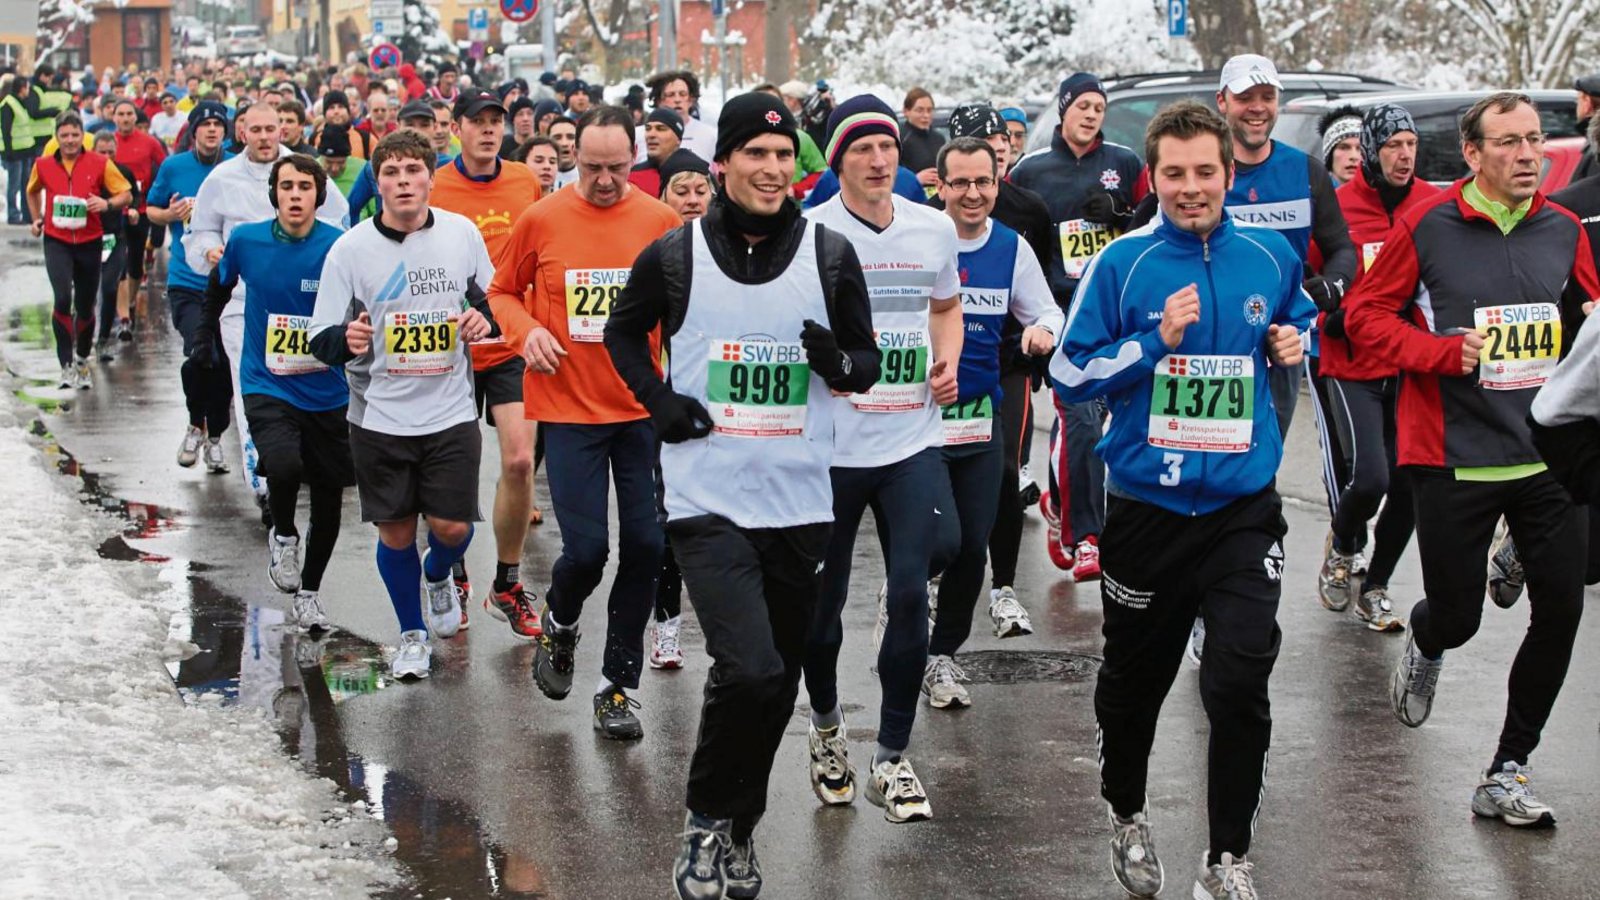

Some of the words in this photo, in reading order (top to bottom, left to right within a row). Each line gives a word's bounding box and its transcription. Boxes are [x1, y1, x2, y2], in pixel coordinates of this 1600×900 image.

[1170, 0, 1183, 31] P
[59, 203, 80, 216] 937
[1231, 210, 1297, 223] NTANIS
[408, 267, 446, 283] DÜRR
[411, 280, 460, 296] DENTAL
[409, 312, 430, 325] SW
[1503, 308, 1527, 323] SW
[272, 329, 312, 355] 248
[393, 325, 450, 353] 2339
[880, 332, 905, 347] SW
[1487, 323, 1554, 361] 2444
[744, 345, 773, 362] SW
[880, 349, 917, 384] 99
[1189, 359, 1217, 376] SW
[730, 364, 791, 405] 998
[1163, 378, 1245, 419] 1379
[1181, 423, 1237, 434] Kreissparkasse
[1180, 433, 1230, 443] Ludwigsburg
[1160, 453, 1184, 487] 3
